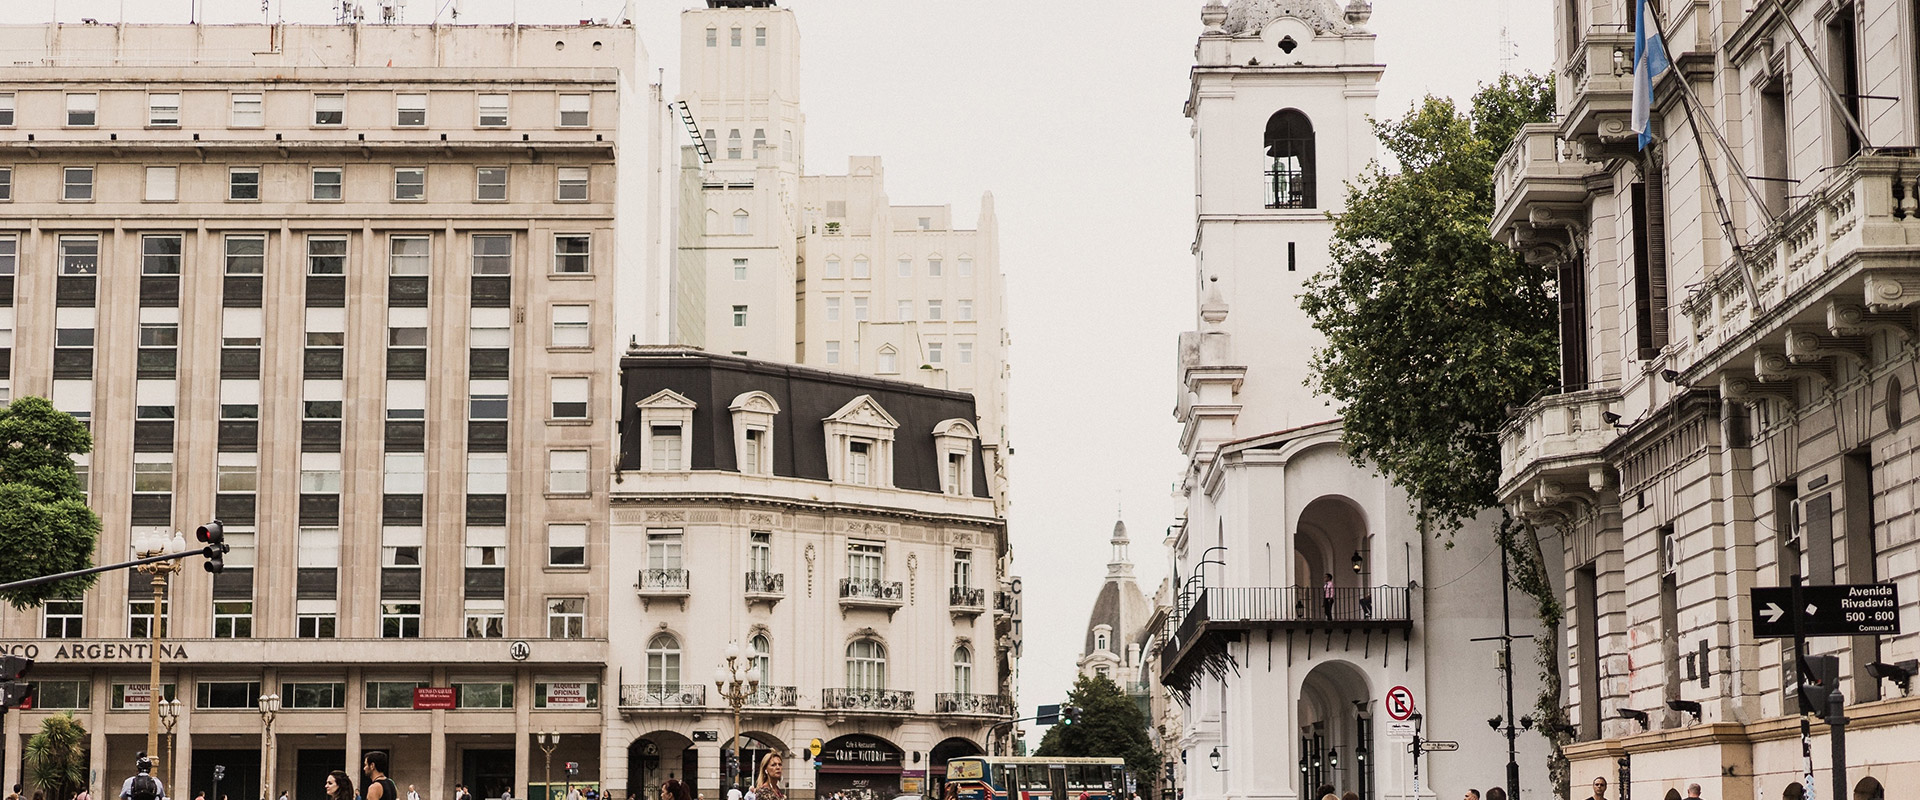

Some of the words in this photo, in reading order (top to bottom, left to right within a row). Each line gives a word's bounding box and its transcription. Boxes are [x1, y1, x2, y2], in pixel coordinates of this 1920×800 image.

[1848, 585, 1893, 597] Avenida
[1841, 597, 1894, 608] Rivadavia
[1011, 579, 1022, 656] CITY
[1845, 611, 1866, 622] 500
[1874, 611, 1895, 621] 600
[1858, 624, 1889, 632] Comuna
[55, 644, 188, 659] ARGENTINA
[835, 749, 853, 761] GRAN
